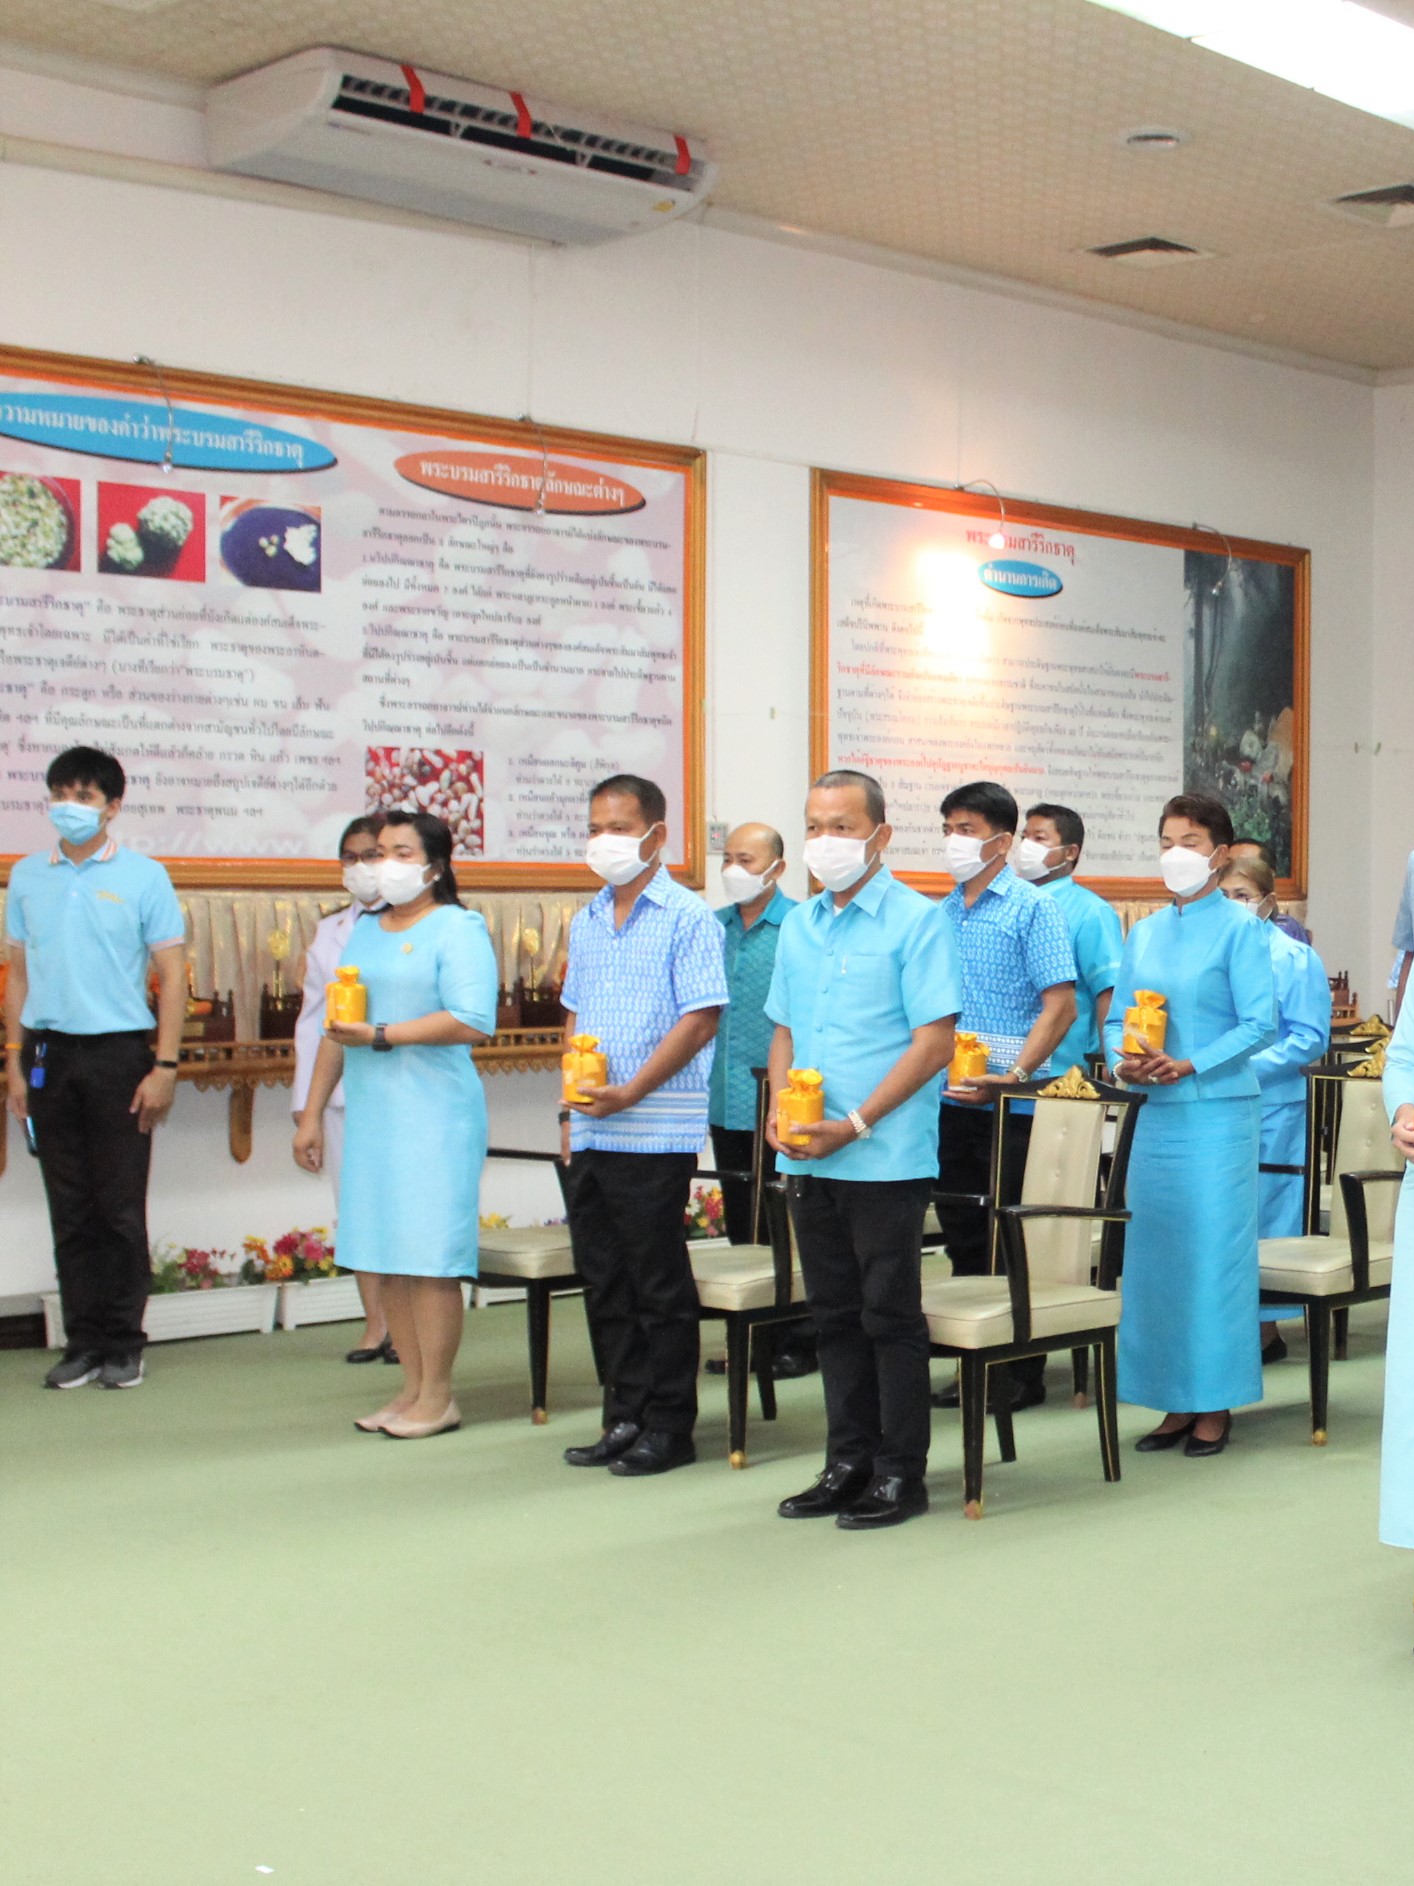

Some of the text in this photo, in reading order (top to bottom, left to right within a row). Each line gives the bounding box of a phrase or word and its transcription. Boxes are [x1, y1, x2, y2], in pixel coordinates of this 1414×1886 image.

[0, 403, 304, 468] วามหมายของคำว่าพระบรมสารีริกธาตุ
[965, 529, 1076, 565] พระมสารีริกธาตุ
